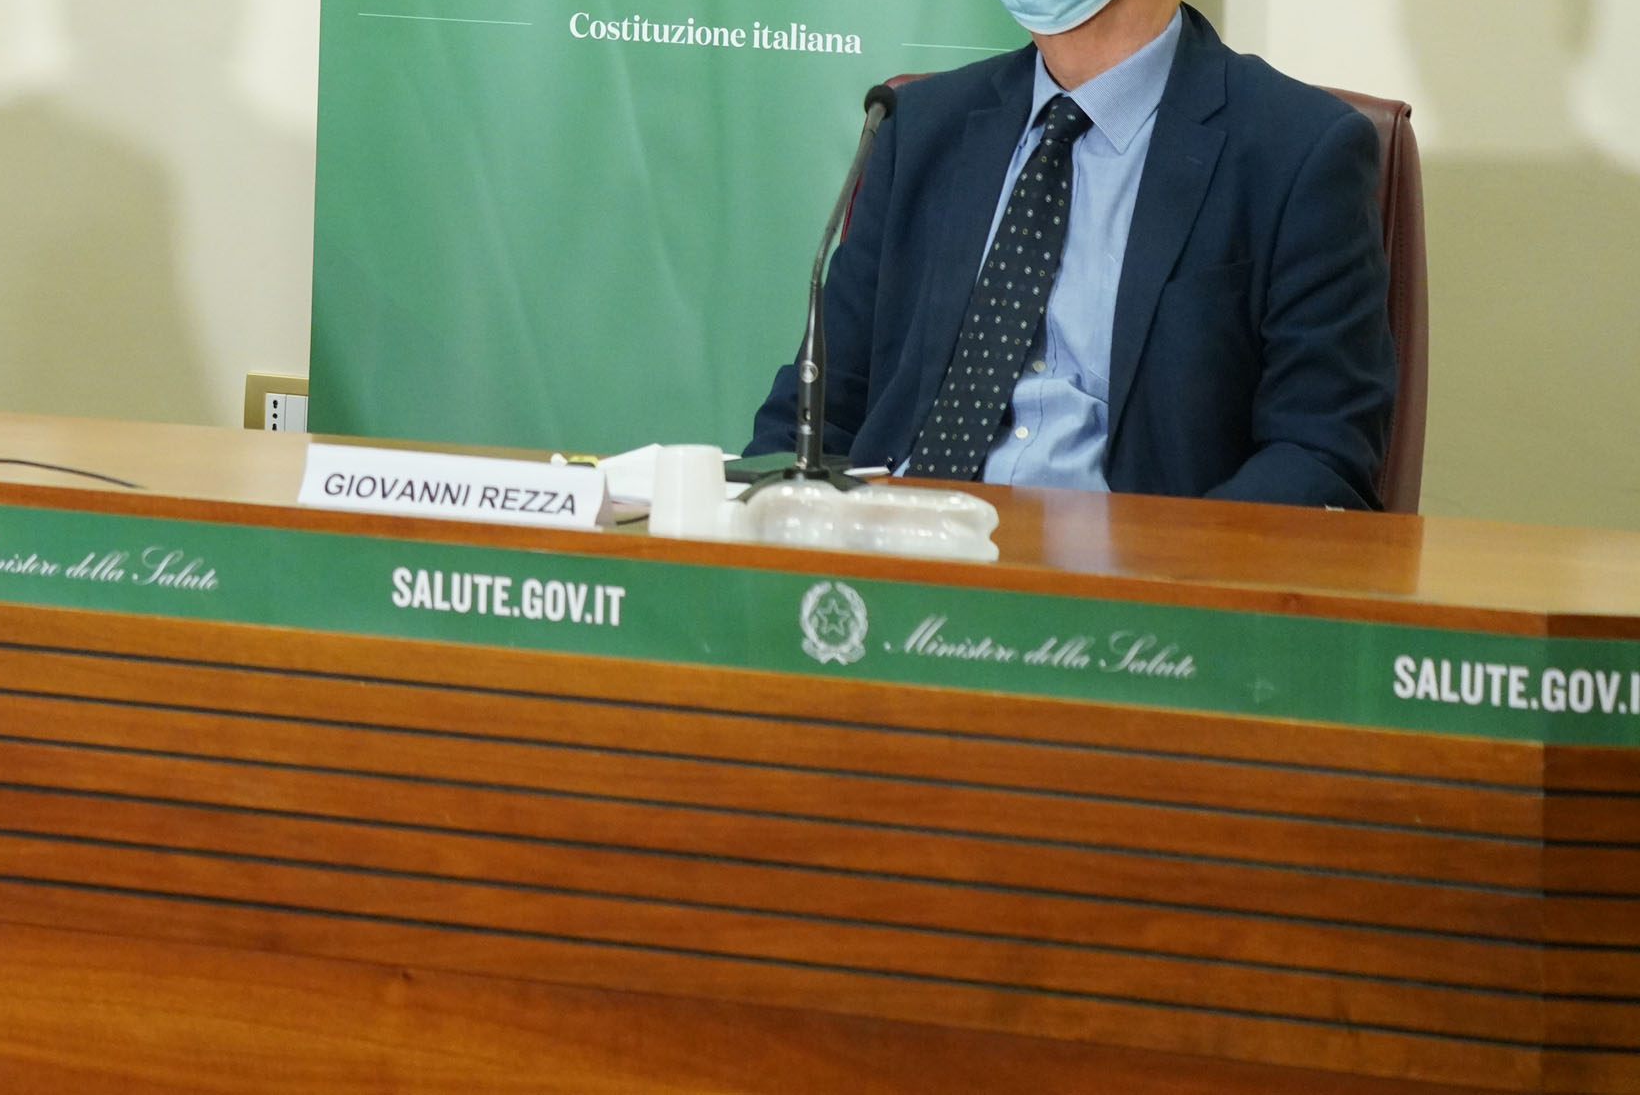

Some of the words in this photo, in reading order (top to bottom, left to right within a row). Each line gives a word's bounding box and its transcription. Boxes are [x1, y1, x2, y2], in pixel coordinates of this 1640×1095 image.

[570, 13, 746, 47] Costituzione
[753, 22, 862, 54] italiana
[325, 474, 470, 506] GIOVANNI
[479, 486, 575, 515] REZZA
[64, 551, 130, 584] della
[392, 567, 625, 626] SALUTE.GOV.IT
[1393, 654, 1640, 716] SALUTE.GOV.I
